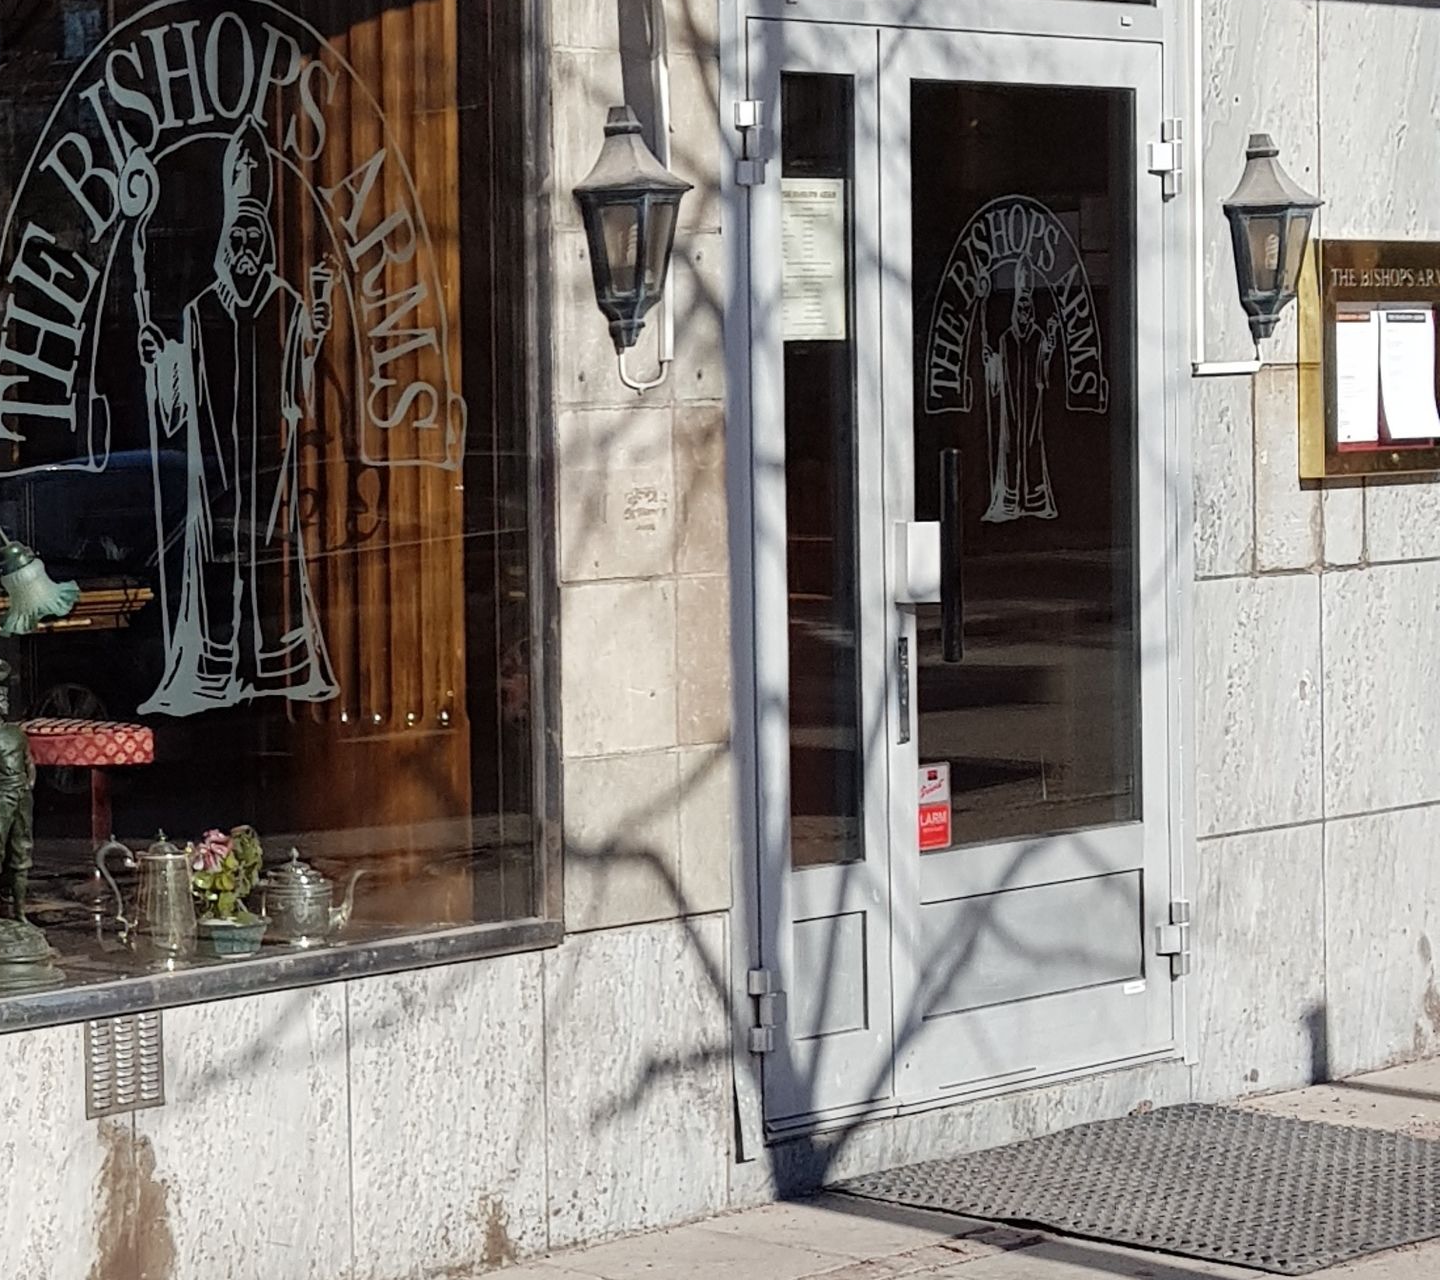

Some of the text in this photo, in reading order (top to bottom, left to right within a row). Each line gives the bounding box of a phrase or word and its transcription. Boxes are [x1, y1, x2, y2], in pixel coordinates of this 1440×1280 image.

[39, 11, 339, 245] BISHOPS
[318, 148, 441, 431] ARMS
[947, 203, 1060, 312] BISHOPS
[1330, 268, 1357, 287] THE
[1360, 268, 1415, 287] BISHOPS
[930, 303, 970, 400] THE
[1051, 263, 1099, 396] ARMS
[920, 810, 947, 827] LARM
